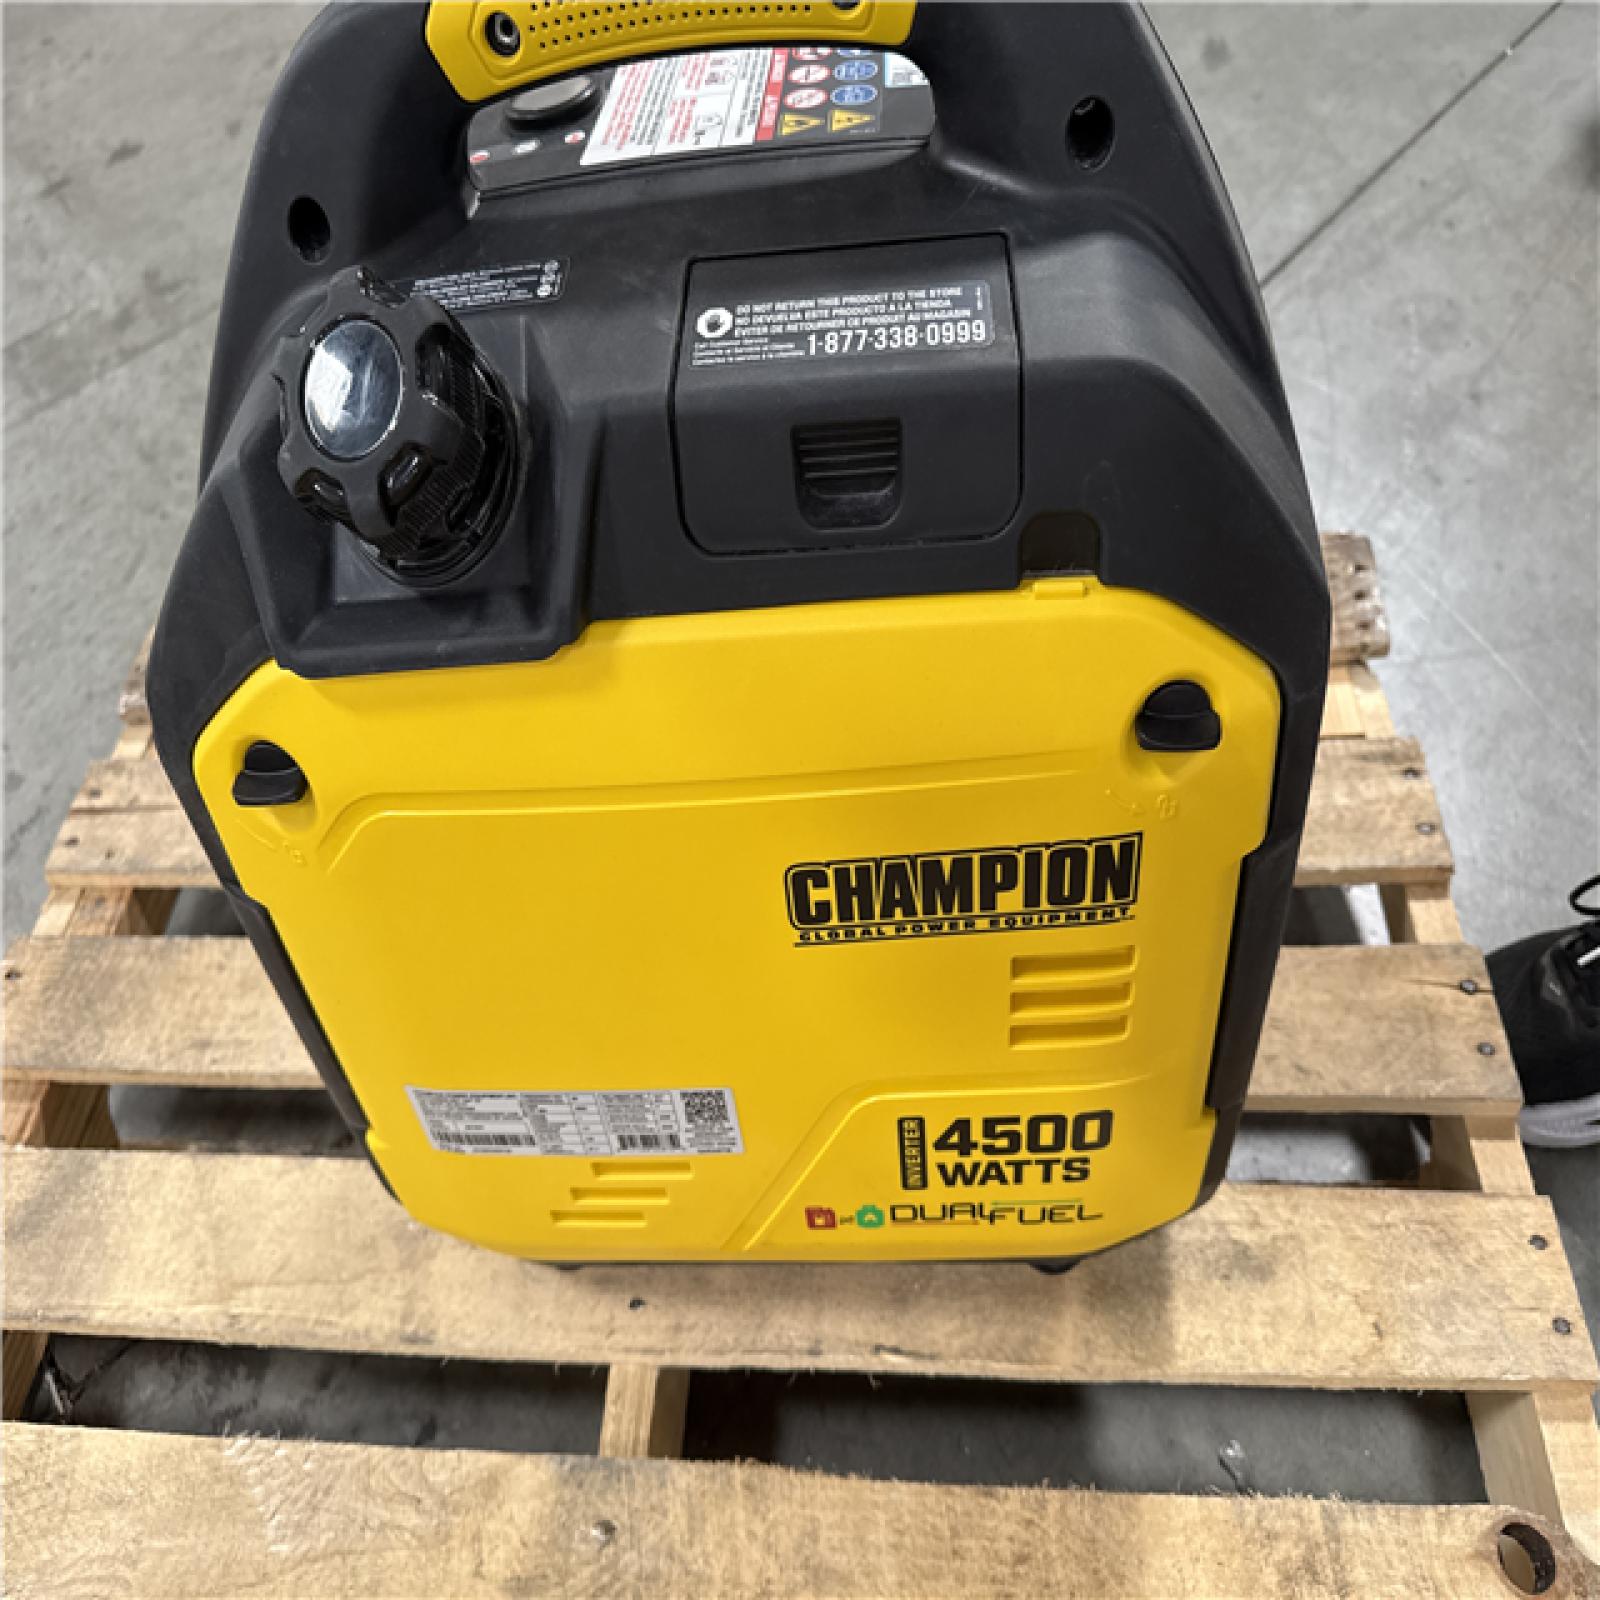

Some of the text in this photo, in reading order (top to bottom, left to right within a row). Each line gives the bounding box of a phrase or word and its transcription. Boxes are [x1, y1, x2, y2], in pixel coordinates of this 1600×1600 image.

[791, 837, 1138, 927] CHAMPION
[799, 926, 885, 942] GLOBAL
[895, 919, 976, 935] POWER
[933, 1109, 1114, 1158] 4500
[936, 1157, 1091, 1188] WATTS
